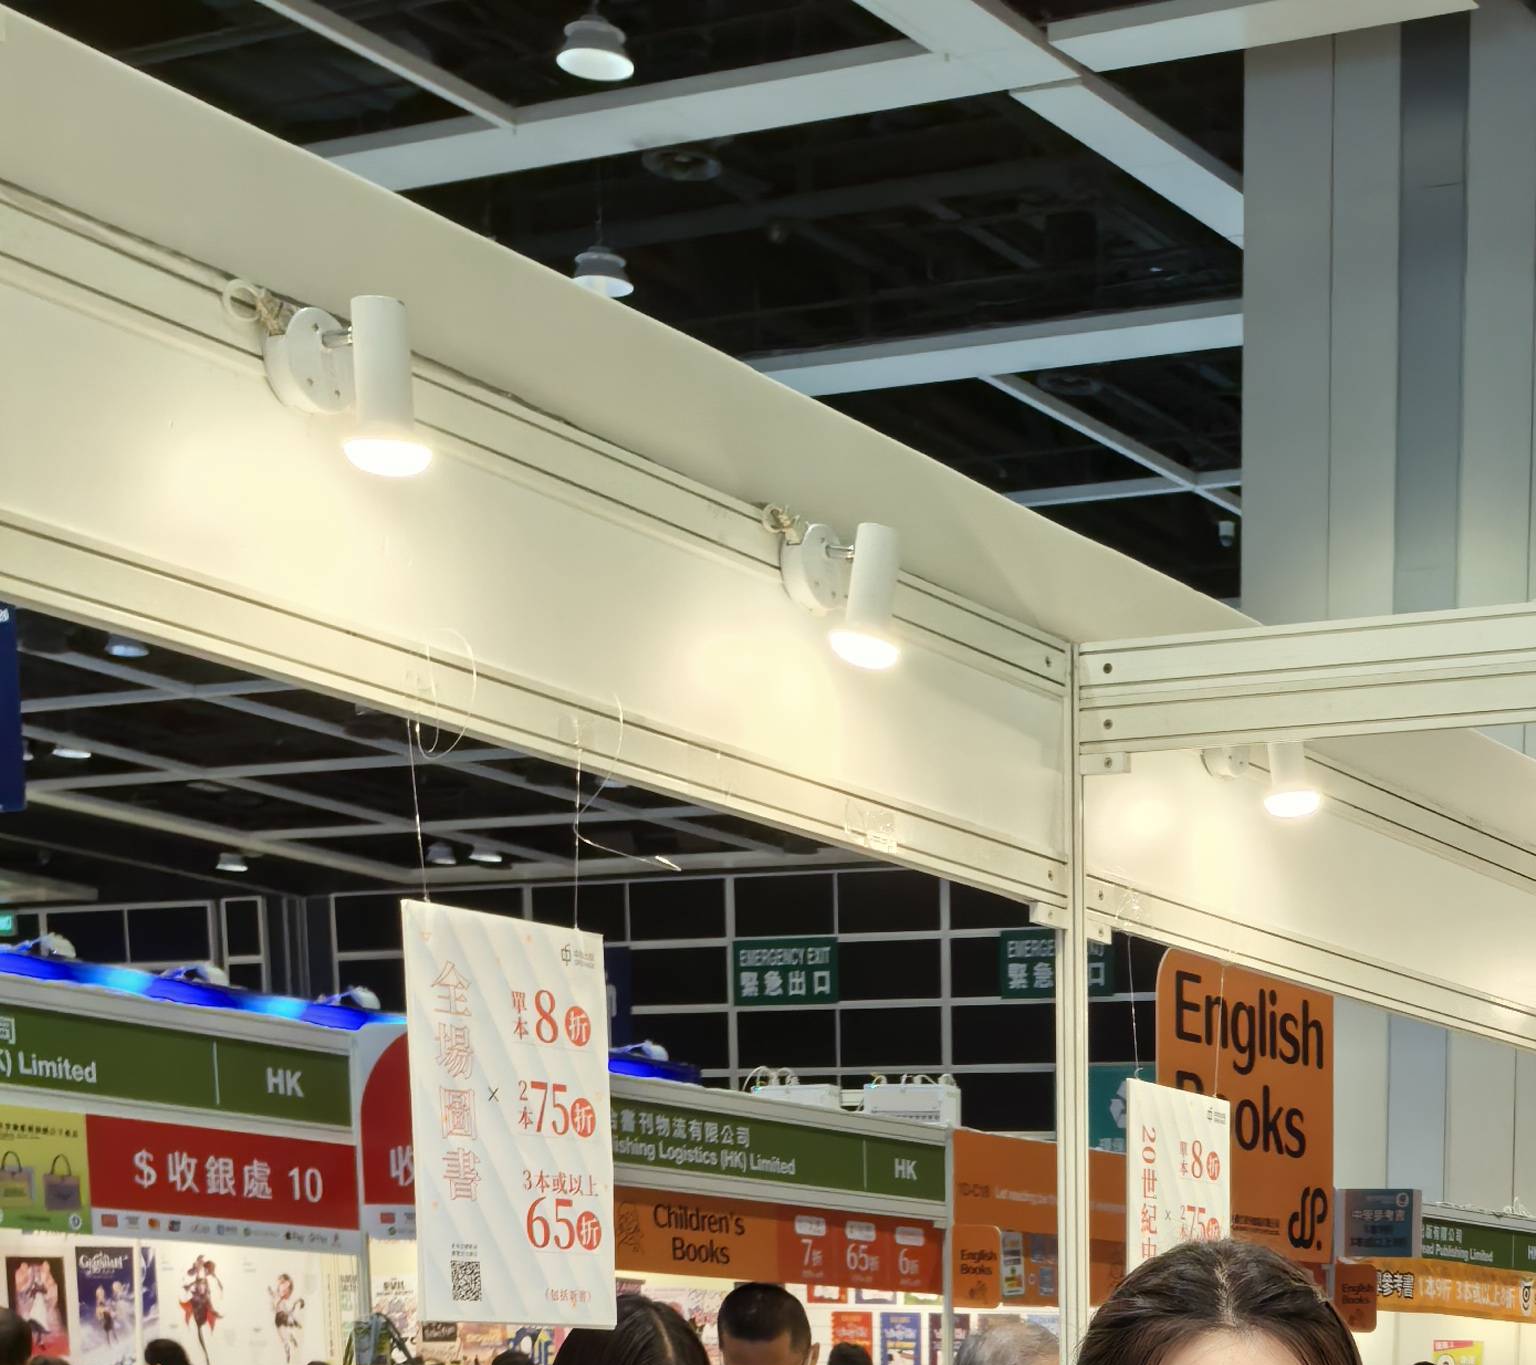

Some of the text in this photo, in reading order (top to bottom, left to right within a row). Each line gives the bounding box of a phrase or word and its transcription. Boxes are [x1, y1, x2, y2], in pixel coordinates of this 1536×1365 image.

[740, 946, 830, 967] EMERGENCY EXIT
[740, 970, 831, 998] 緊急出口
[1175, 970, 1324, 1075] English
[18, 1051, 97, 1084] Limited
[266, 1067, 304, 1097] HK
[430, 960, 480, 1201] 全場圖書
[659, 1141, 718, 1170] Logistics
[720, 1147, 747, 1172] (HK)
[750, 1152, 796, 1176] Limited
[895, 1158, 918, 1181] HK
[167, 1151, 273, 1201] 收銀處
[288, 1168, 323, 1203] 10
[523, 1169, 599, 1197] 3本或以上
[653, 1203, 746, 1236] Children's
[672, 1237, 731, 1265] Books
